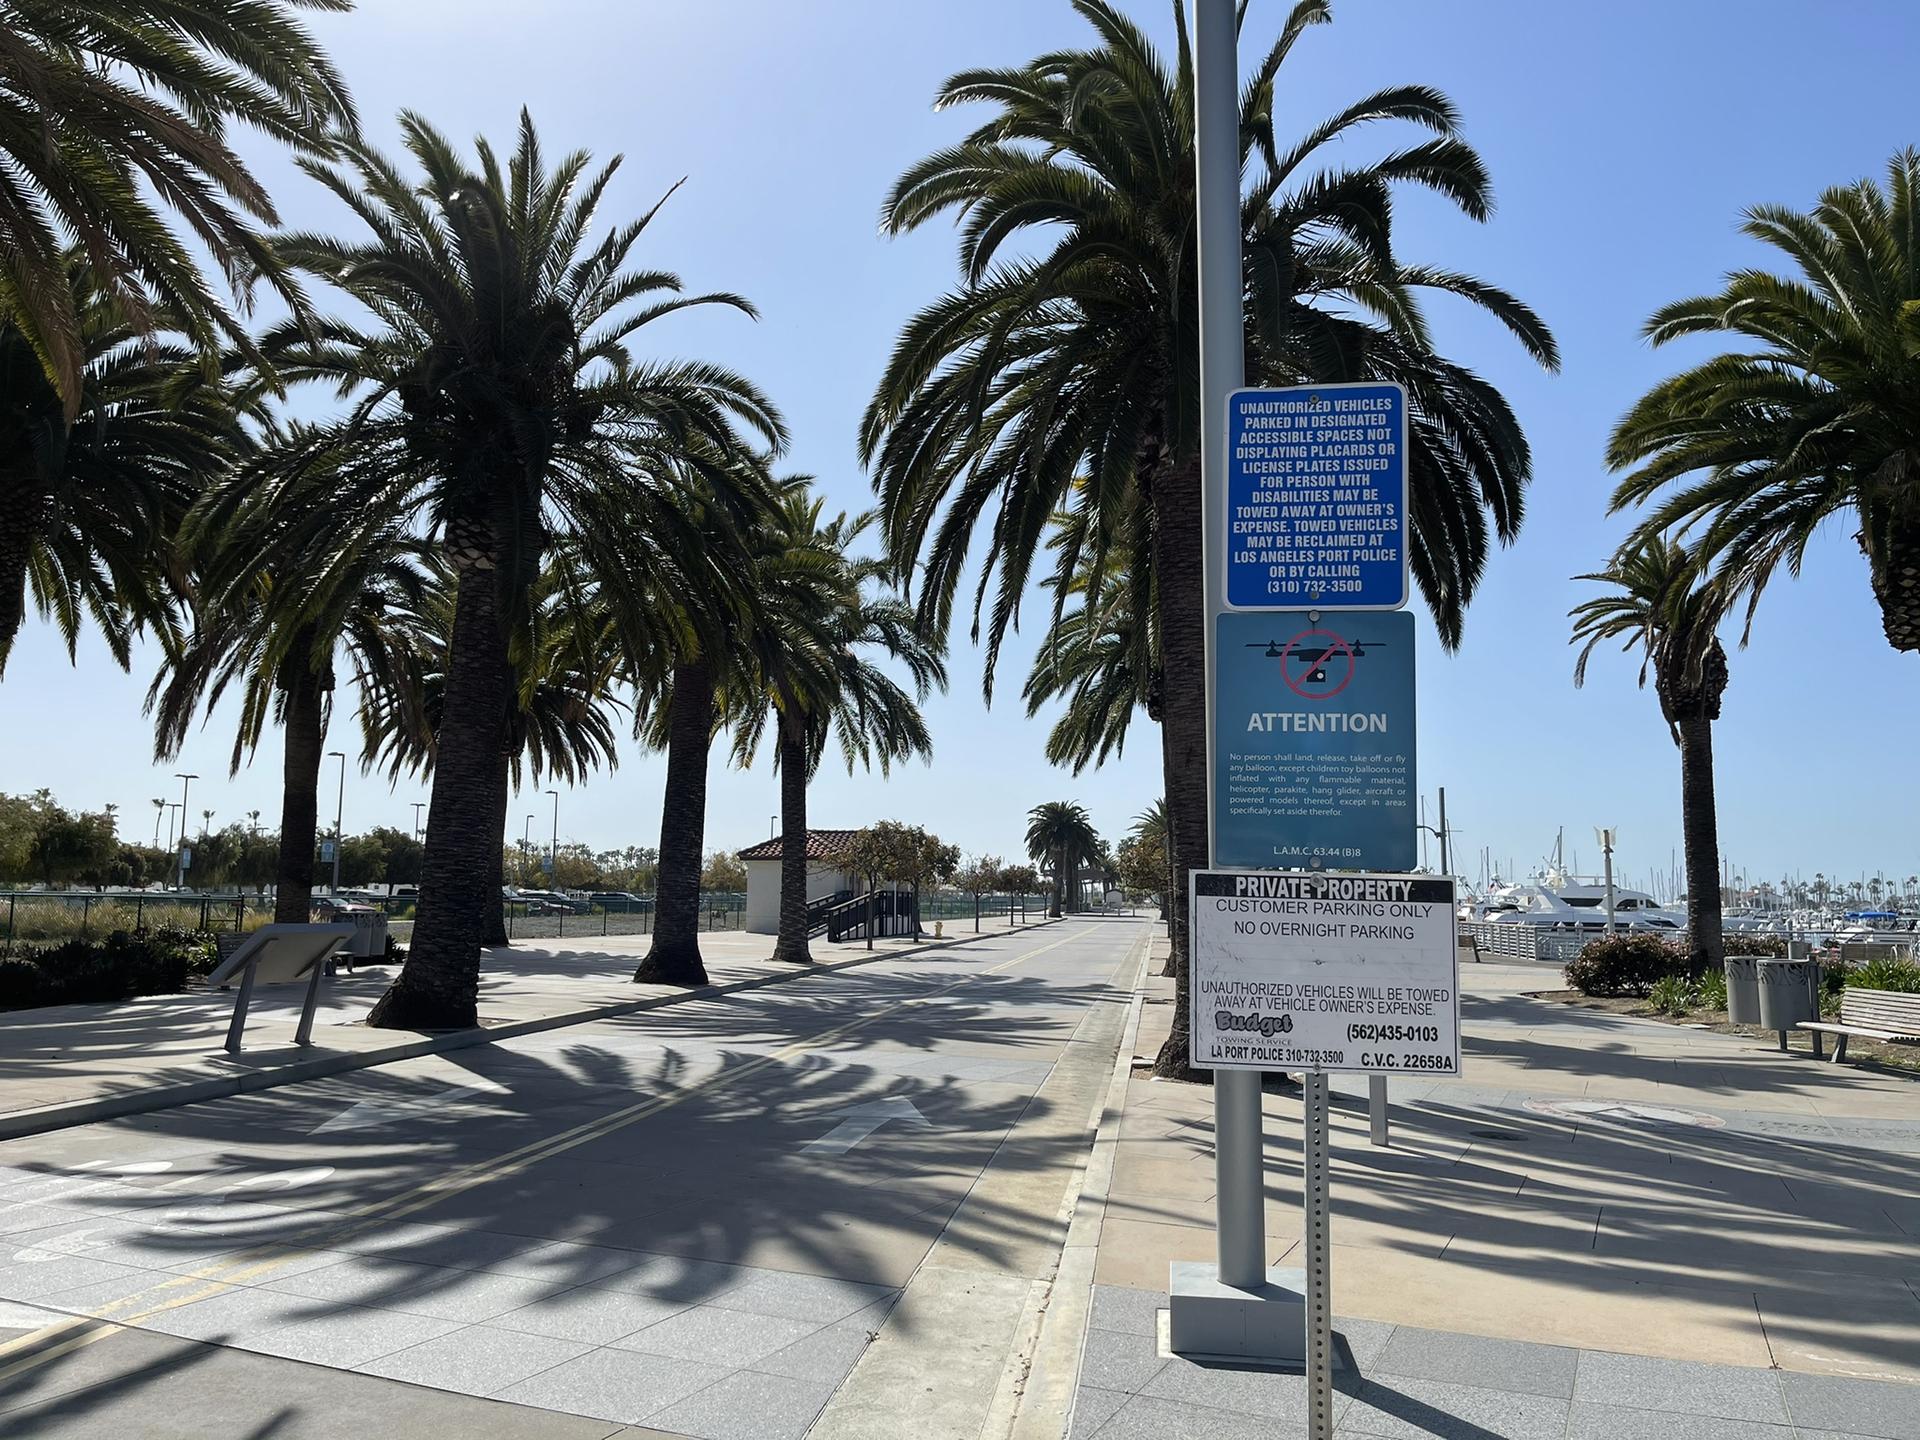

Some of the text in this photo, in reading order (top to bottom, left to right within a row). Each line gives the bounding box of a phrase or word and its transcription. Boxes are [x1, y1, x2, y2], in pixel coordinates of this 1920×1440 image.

[1240, 398, 1392, 414] UNAUTHORIZED VEHICLES
[1245, 414, 1386, 429] PARKED IN DESIGNATED
[1240, 428, 1391, 444] ACCESSIBLE SPACES NOT
[1236, 443, 1395, 459] DISPLAYING PLACARDS OR
[1243, 459, 1388, 473] LICENSE PLATES ISSUED
[1260, 474, 1370, 488] FOR PERSON WITH
[1252, 489, 1378, 503] DISABILITIES MAY BE
[1237, 504, 1394, 518] TOWED AWAY AT OWNER'S
[1233, 519, 1398, 533] EXPENSE. TOWED VEHICLES
[1247, 534, 1383, 548] MAY BE RECLAIMED AT
[1234, 549, 1396, 563] LOS ANGELES PORT POLICE
[1270, 564, 1360, 577] OR BY CALLING
[1268, 580, 1362, 593] (310) 732-3500
[1247, 713, 1387, 732] ATTENTION
[1244, 754, 1271, 762] person
[1350, 754, 1367, 762] take
[1370, 754, 1381, 762] off
[1396, 754, 1406, 763] fly
[1230, 765, 1243, 773] any
[1279, 765, 1305, 773] except
[1341, 766, 1353, 775] toy
[1312, 787, 1332, 796] hang
[1230, 796, 1264, 804] powered
[1230, 807, 1271, 816] specifically
[1342, 847, 1361, 857] (B)8
[1236, 877, 1412, 901] PRIVATE PROPERTY
[1216, 899, 1432, 918] CUSTOMER PARKING ONLY
[1234, 921, 1414, 939] NO OVERNIGHT PARKING
[1202, 981, 1449, 1002] UNAUTHORIZED VEHICLES WILL BE TOWED
[1214, 996, 1436, 1016] AWAY AT VEHICLE OWNER'S EXPENSE.
[1215, 1011, 1293, 1037] Budget
[1216, 1037, 1254, 1045] TOWING
[1347, 1024, 1438, 1044] (562)435-0103
[1211, 1046, 1343, 1064] LA PORT POLICE 310-732-3500
[1362, 1053, 1452, 1070] C.V.C. 22658A
